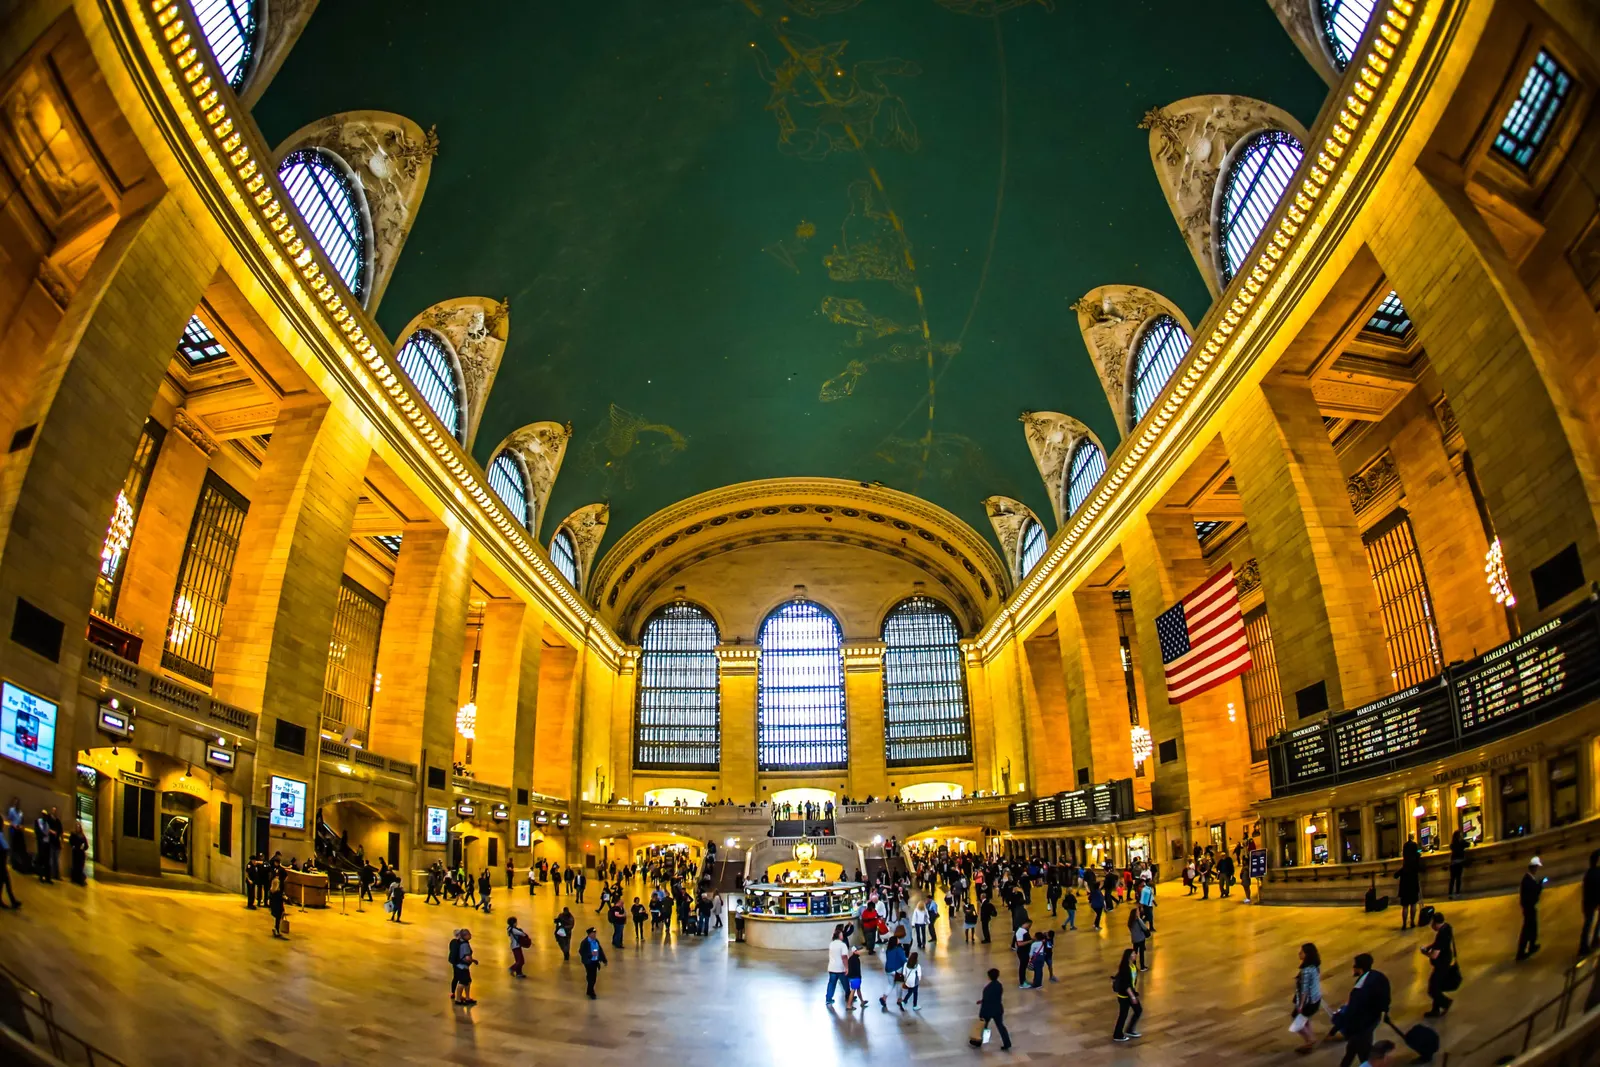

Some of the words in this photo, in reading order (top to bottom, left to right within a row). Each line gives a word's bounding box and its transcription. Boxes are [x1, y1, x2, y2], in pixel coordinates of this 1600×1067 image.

[1484, 646, 1508, 663] HARLEM
[1509, 640, 1522, 651] LINE
[1524, 618, 1561, 643] DEPARTURES
[1481, 661, 1511, 677] DESTINATION
[1517, 647, 1538, 661] REMARKS
[1357, 704, 1376, 716] HARLEM
[1377, 700, 1387, 708] LINE
[1389, 688, 1419, 704] DEPARTURES
[1355, 716, 1378, 726] DESTINATION
[1383, 708, 1400, 717] REMARKS
